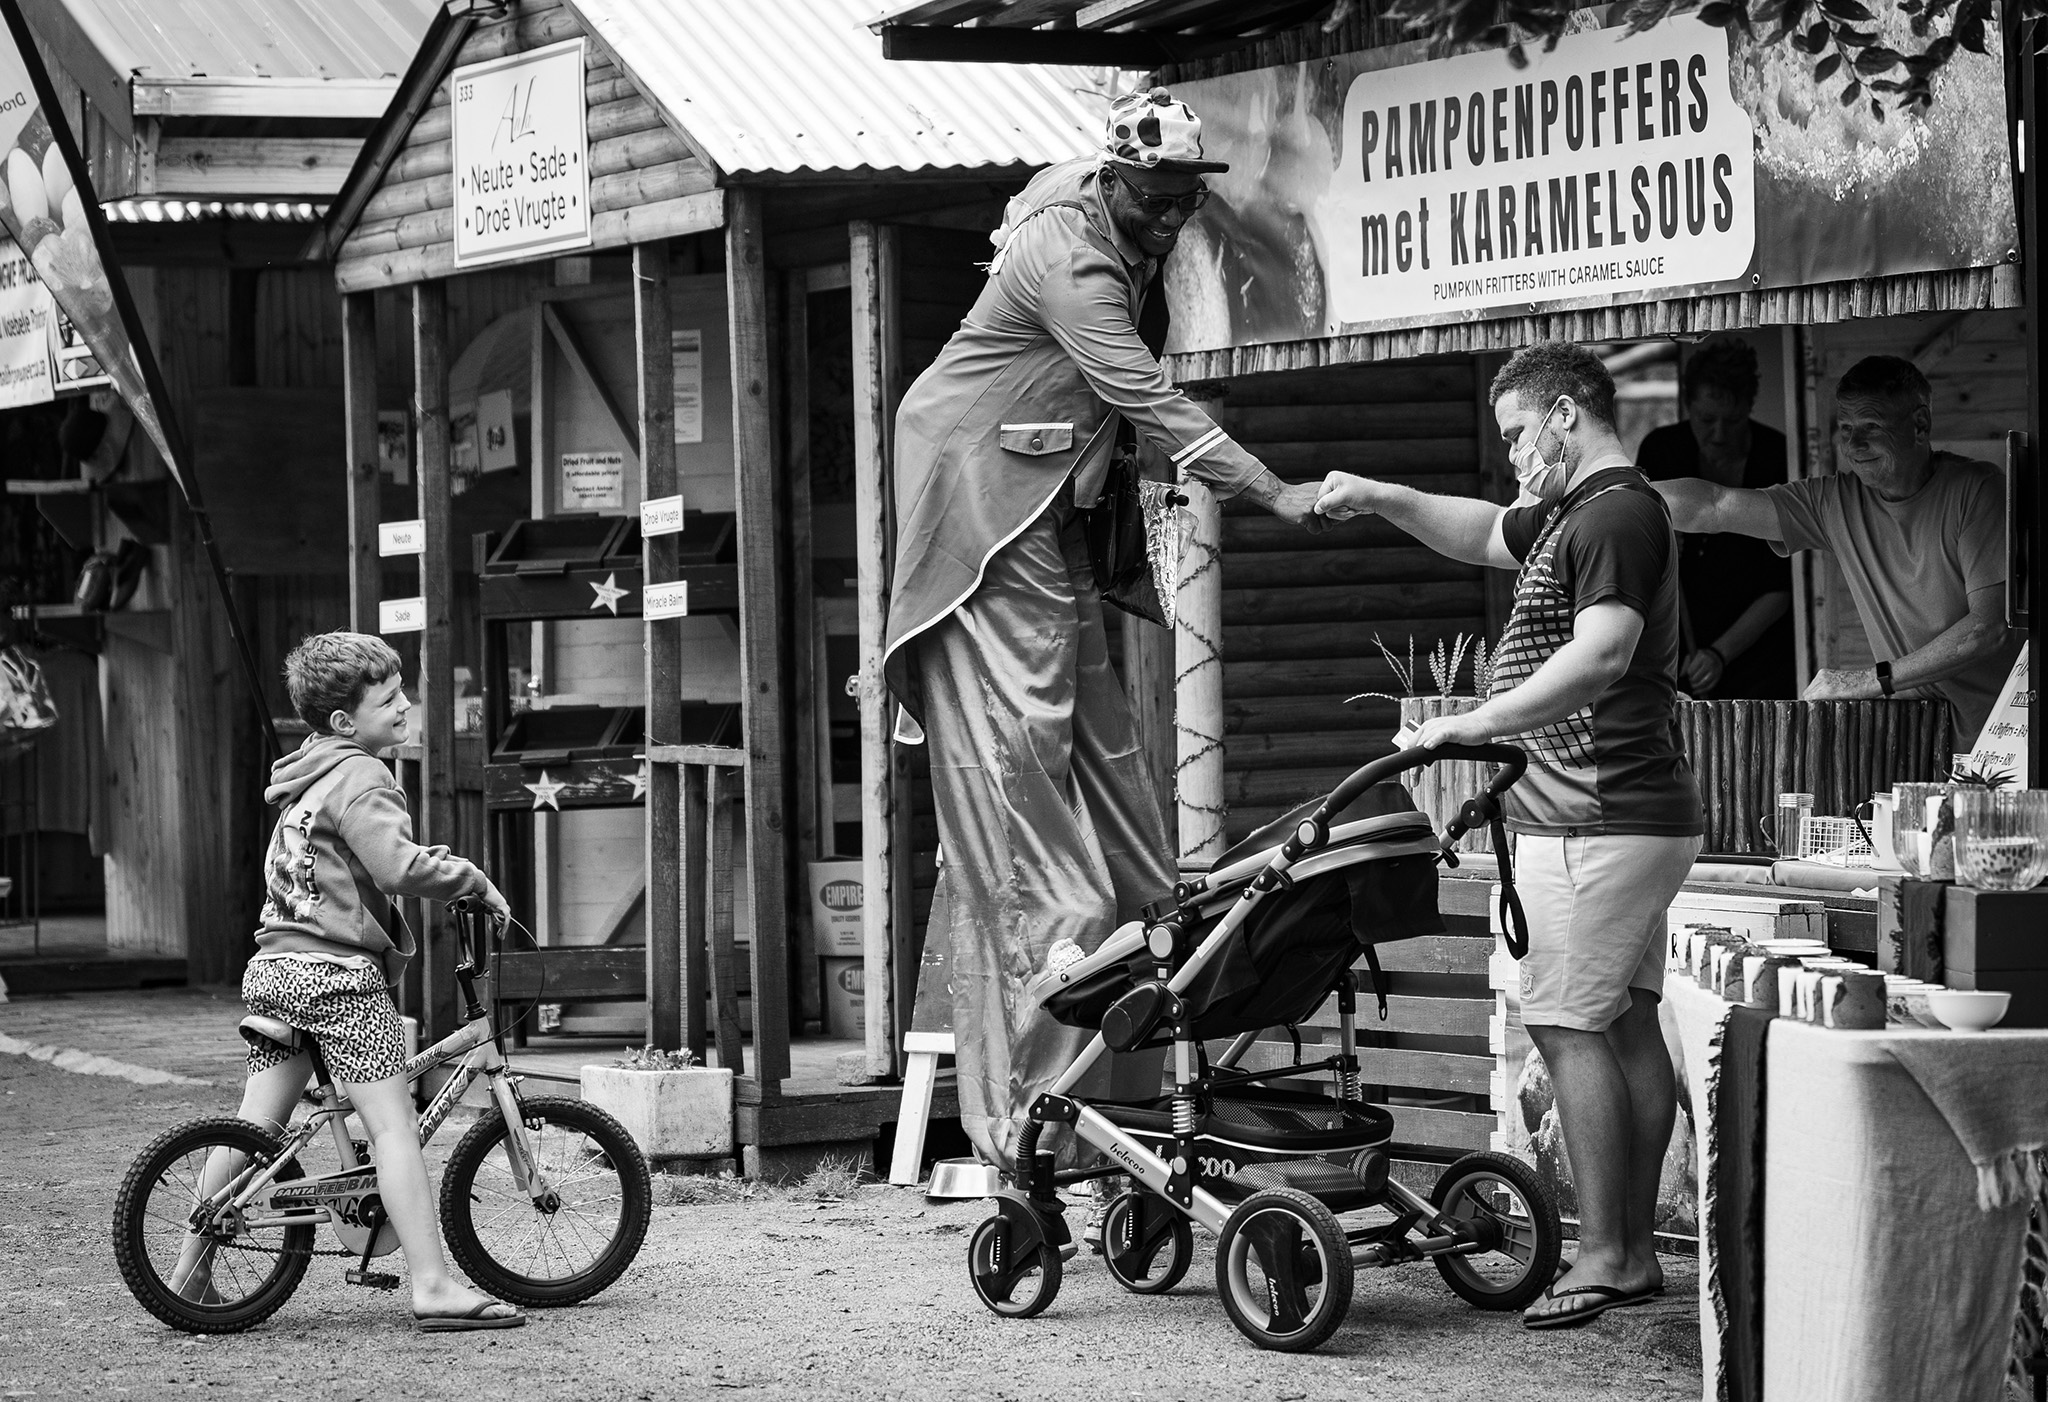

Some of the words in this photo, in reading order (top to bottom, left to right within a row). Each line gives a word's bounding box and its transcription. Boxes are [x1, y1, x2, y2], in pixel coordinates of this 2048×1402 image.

[459, 84, 473, 102] 333
[1361, 54, 1708, 182] PAMPOENPOFFERS
[471, 160, 513, 196] Neute
[530, 145, 567, 183] Sade
[475, 199, 510, 236] Droë
[514, 191, 566, 229] Vrugte
[1361, 198, 1430, 277] met
[1450, 153, 1733, 266] KARAMELSOUS
[1433, 277, 1483, 301] PUMPKIN
[1485, 271, 1536, 296] FRITTERS
[1537, 268, 1567, 290] WITH
[1568, 262, 1623, 287] CARAMEL
[1625, 257, 1665, 279] SAUCE
[563, 457, 578, 466] Dried
[580, 457, 594, 465] Fruit
[595, 457, 606, 465] and
[607, 456, 621, 464] Nuts
[660, 509, 679, 524] Vrugte
[393, 533, 412, 545] Neute
[647, 597, 667, 609] Miracle
[669, 594, 684, 607] Balm
[395, 610, 411, 622] Sade
[825, 885, 864, 907] EMPIRE
[406, 1052, 436, 1074] BMX
[1109, 1142, 1145, 1175] belecoo
[274, 1186, 316, 1198] SANTA
[315, 1181, 349, 1196] FEE
[346, 1177, 378, 1191] BM
[1269, 1277, 1280, 1316] belecoo
